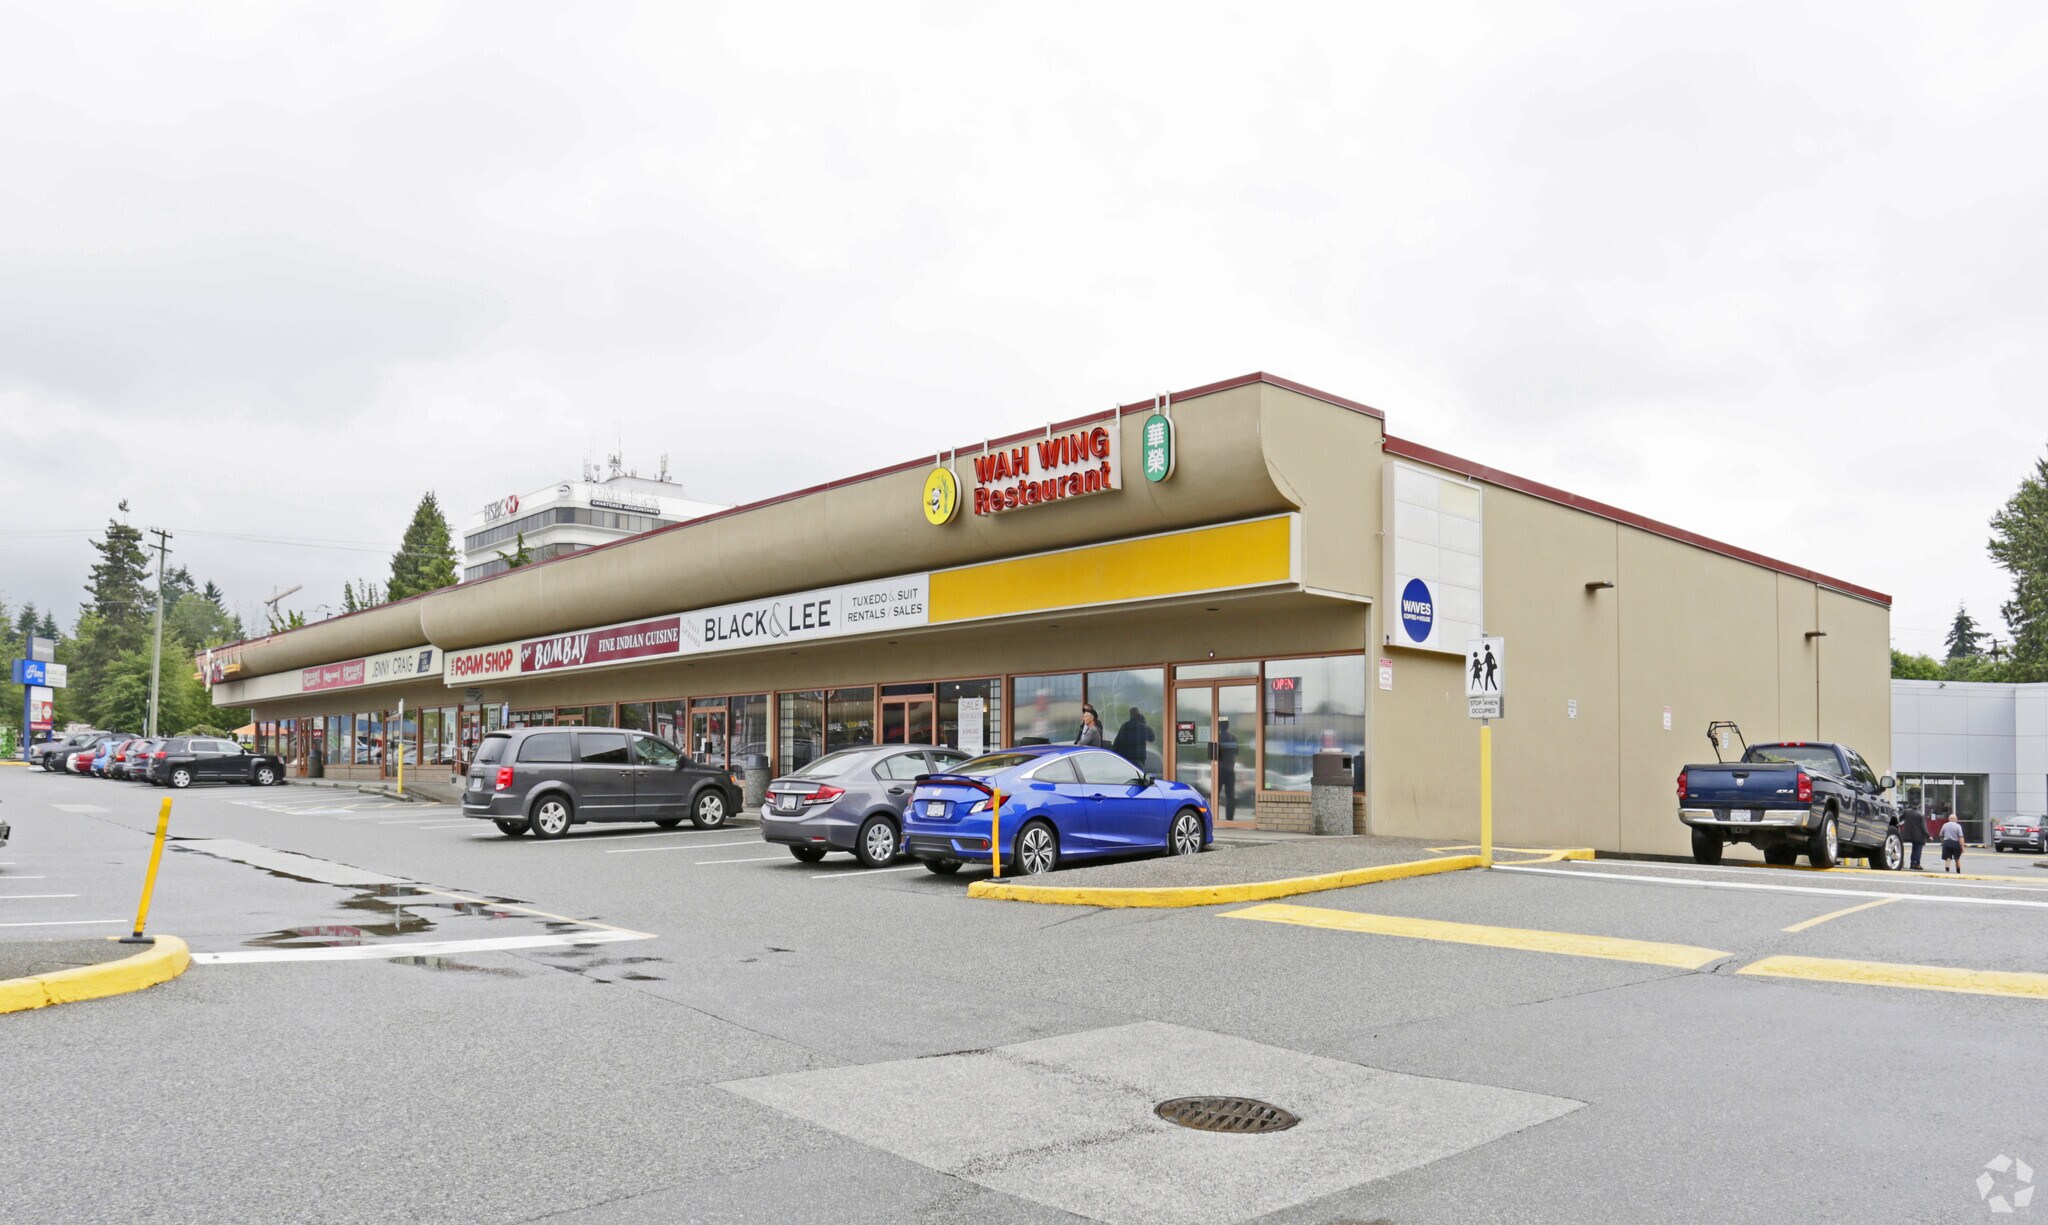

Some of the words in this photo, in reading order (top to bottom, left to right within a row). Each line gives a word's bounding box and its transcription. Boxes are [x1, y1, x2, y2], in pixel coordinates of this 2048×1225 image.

[973, 446, 1029, 484] WAH
[1037, 427, 1110, 470] WING
[1147, 422, 1165, 474] 華榮
[974, 461, 1111, 515] Restaurant
[484, 499, 506, 522] HSBC
[592, 501, 623, 510] CHARTERED
[624, 505, 660, 515] ACCOUNTANTS
[852, 593, 888, 606] TUXEDO
[897, 588, 918, 601] SUIT
[1403, 599, 1431, 616] WAVES
[848, 608, 886, 622] RENTALS
[893, 603, 923, 617] SALES
[598, 638, 616, 652] FINE
[616, 633, 645, 650] INDIAN
[645, 628, 679, 646] CUISINE
[455, 653, 484, 676] FOAM
[484, 648, 514, 674] SHOP
[534, 634, 590, 670] BOMBAY
[372, 660, 390, 678] JENNY
[393, 655, 413, 674] CRAIG
[1272, 678, 1294, 691] OPEN
[961, 700, 980, 711] SALE
